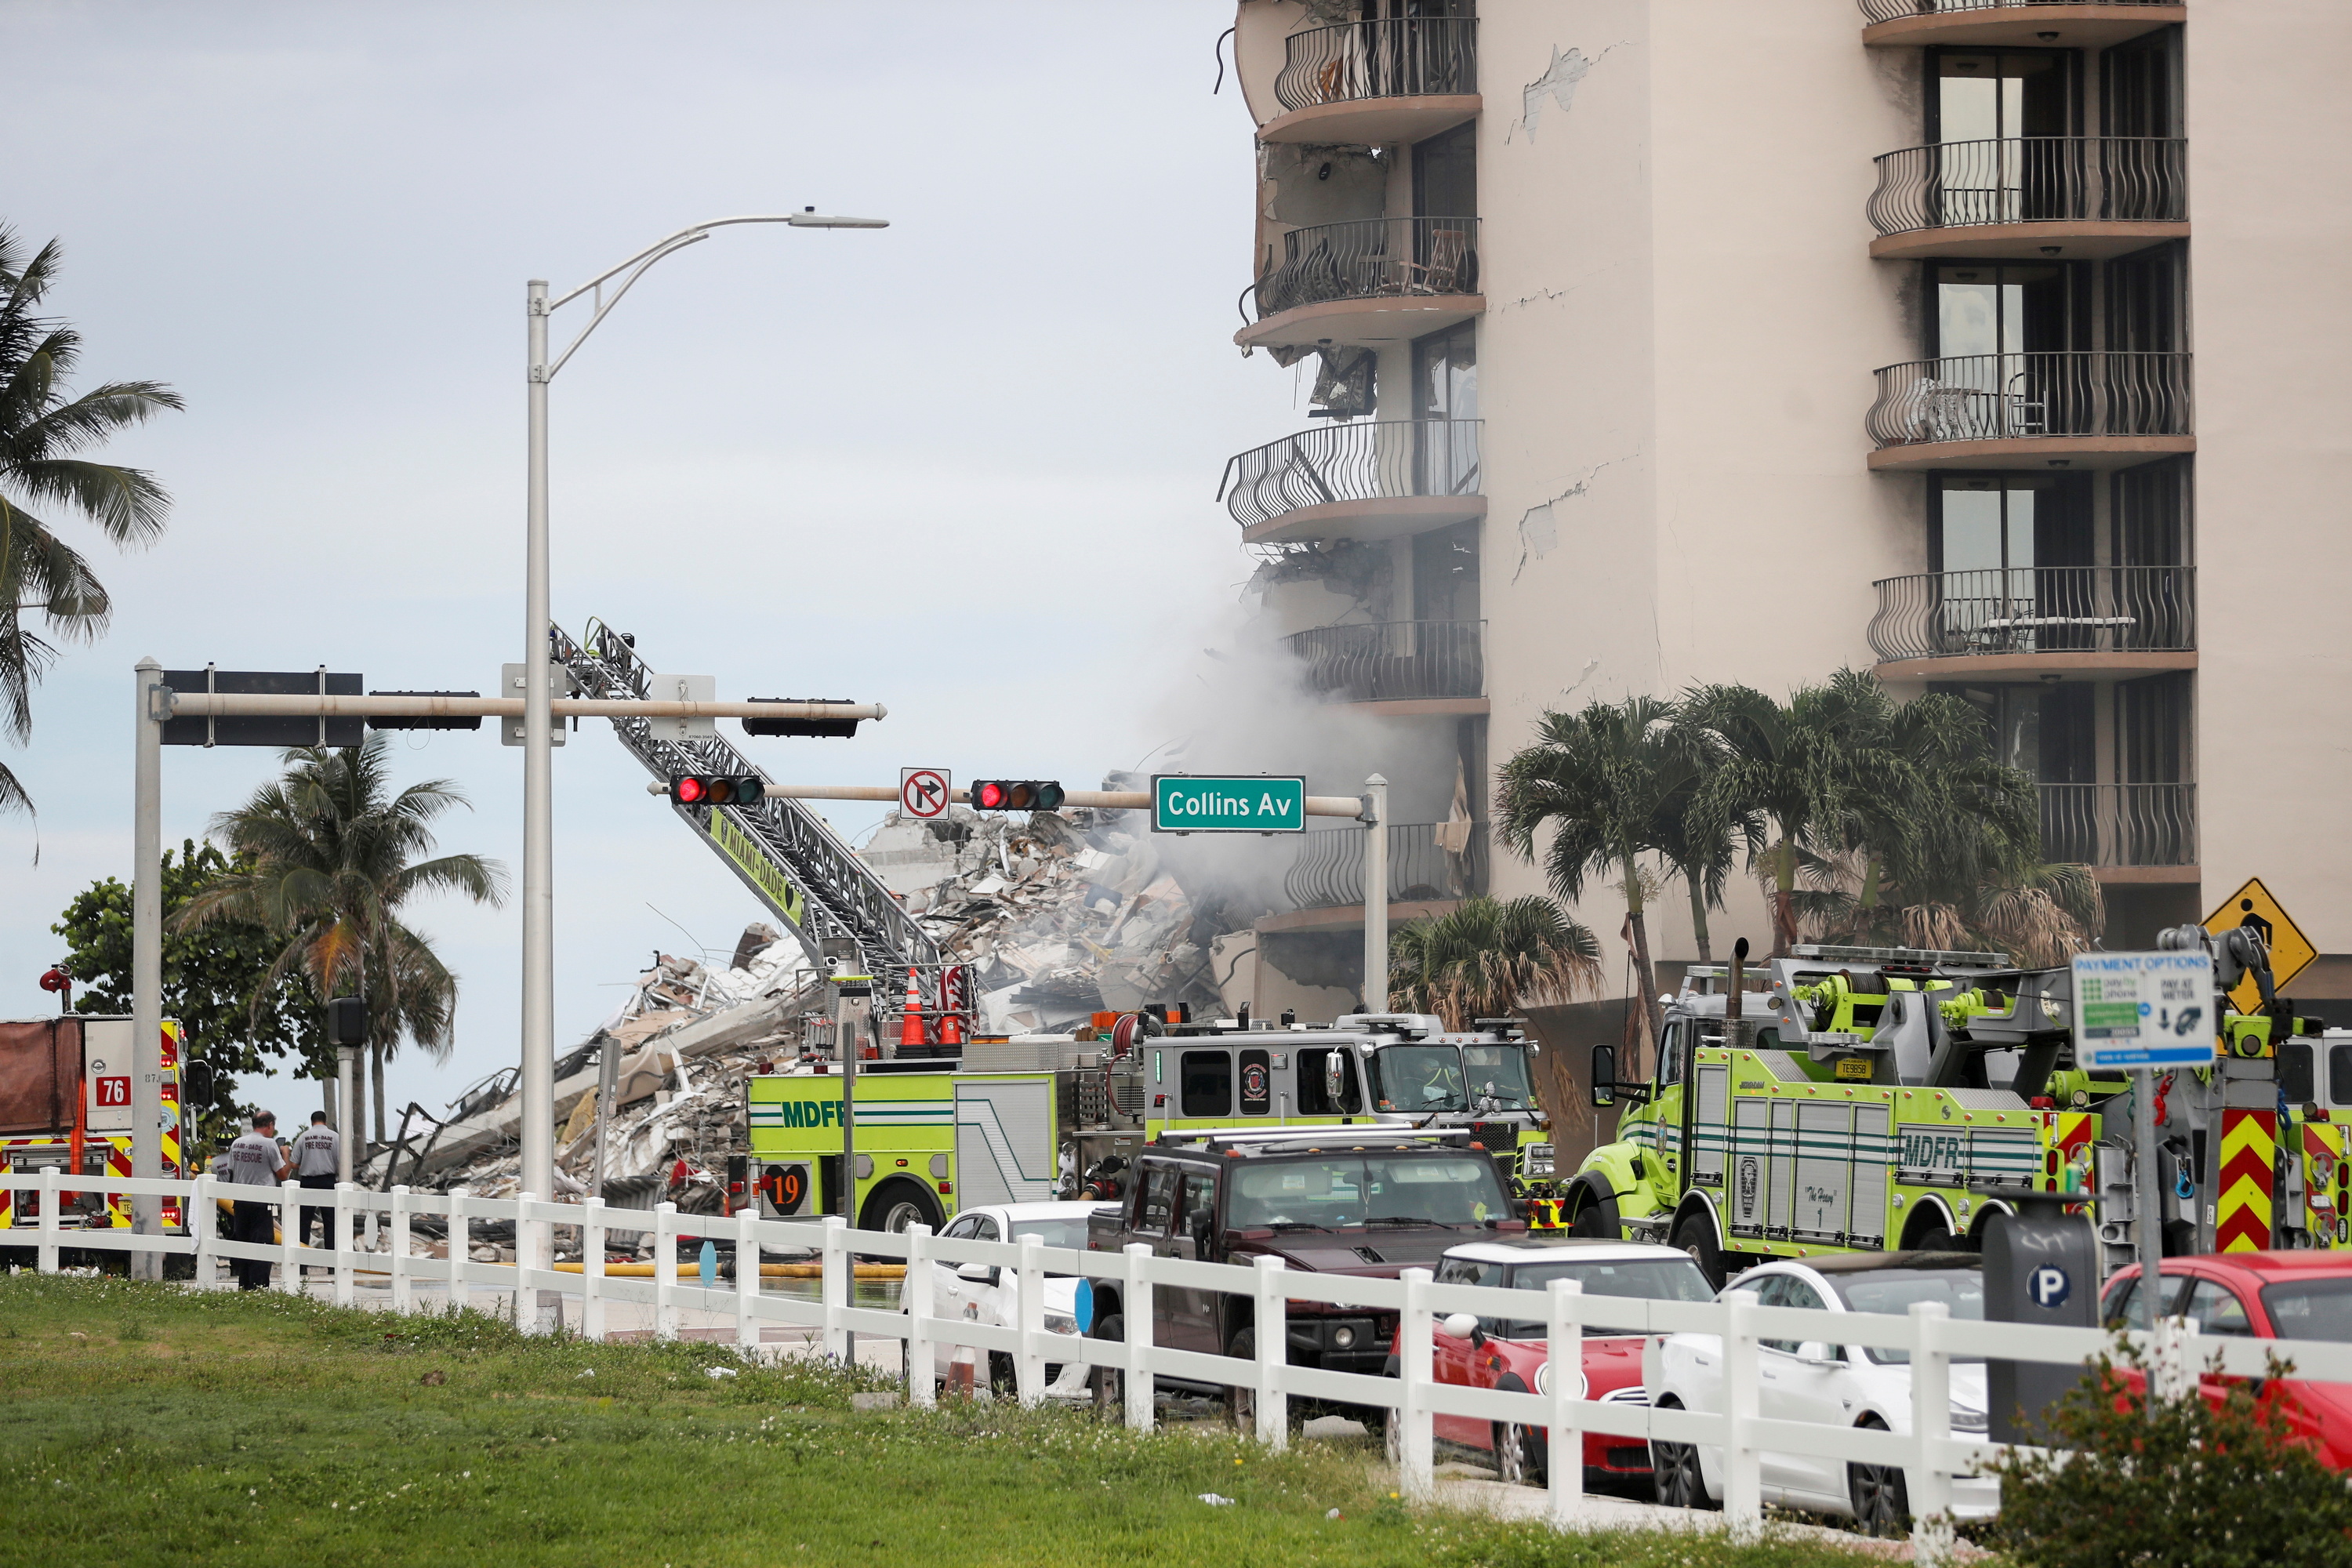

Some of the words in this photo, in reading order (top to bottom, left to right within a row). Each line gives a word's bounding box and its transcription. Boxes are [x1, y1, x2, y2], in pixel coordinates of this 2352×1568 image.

[1168, 791, 1250, 816] Collins
[1257, 793, 1292, 816] Av
[728, 828, 784, 902] MIAMI-DADE
[2075, 956, 2142, 971] PAYMENT
[2144, 955, 2209, 971] OPTIONS
[2160, 978, 2179, 988] PAY
[2161, 989, 2194, 1000] METER
[103, 1080, 124, 1103] 76
[241, 1152, 263, 1163] RESCUE
[305, 1142, 314, 1150] FIRE
[315, 1142, 333, 1151] RESCUE
[1904, 1134, 1959, 1169] MDFR
[773, 1174, 800, 1204] 19
[2038, 1269, 2064, 1305] P
